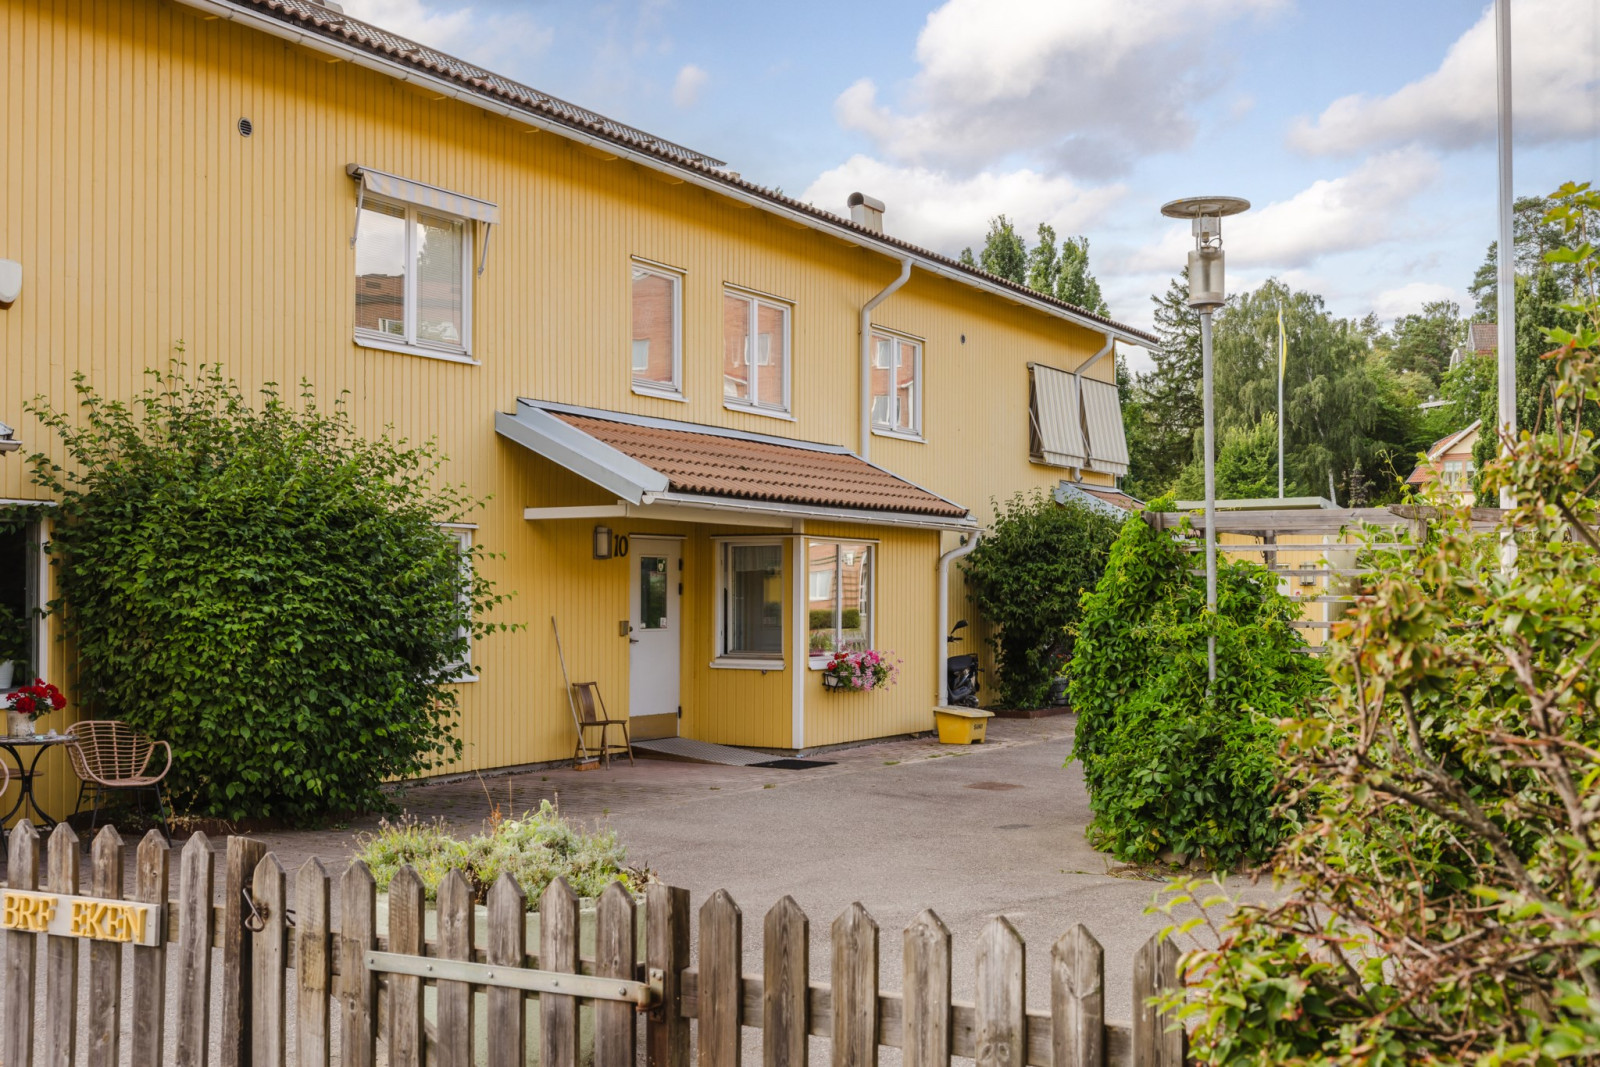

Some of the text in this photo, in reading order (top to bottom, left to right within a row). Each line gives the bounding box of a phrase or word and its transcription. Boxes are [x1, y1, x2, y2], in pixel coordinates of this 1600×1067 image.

[614, 534, 628, 557] 10
[3, 892, 147, 943] BRF EKEN
